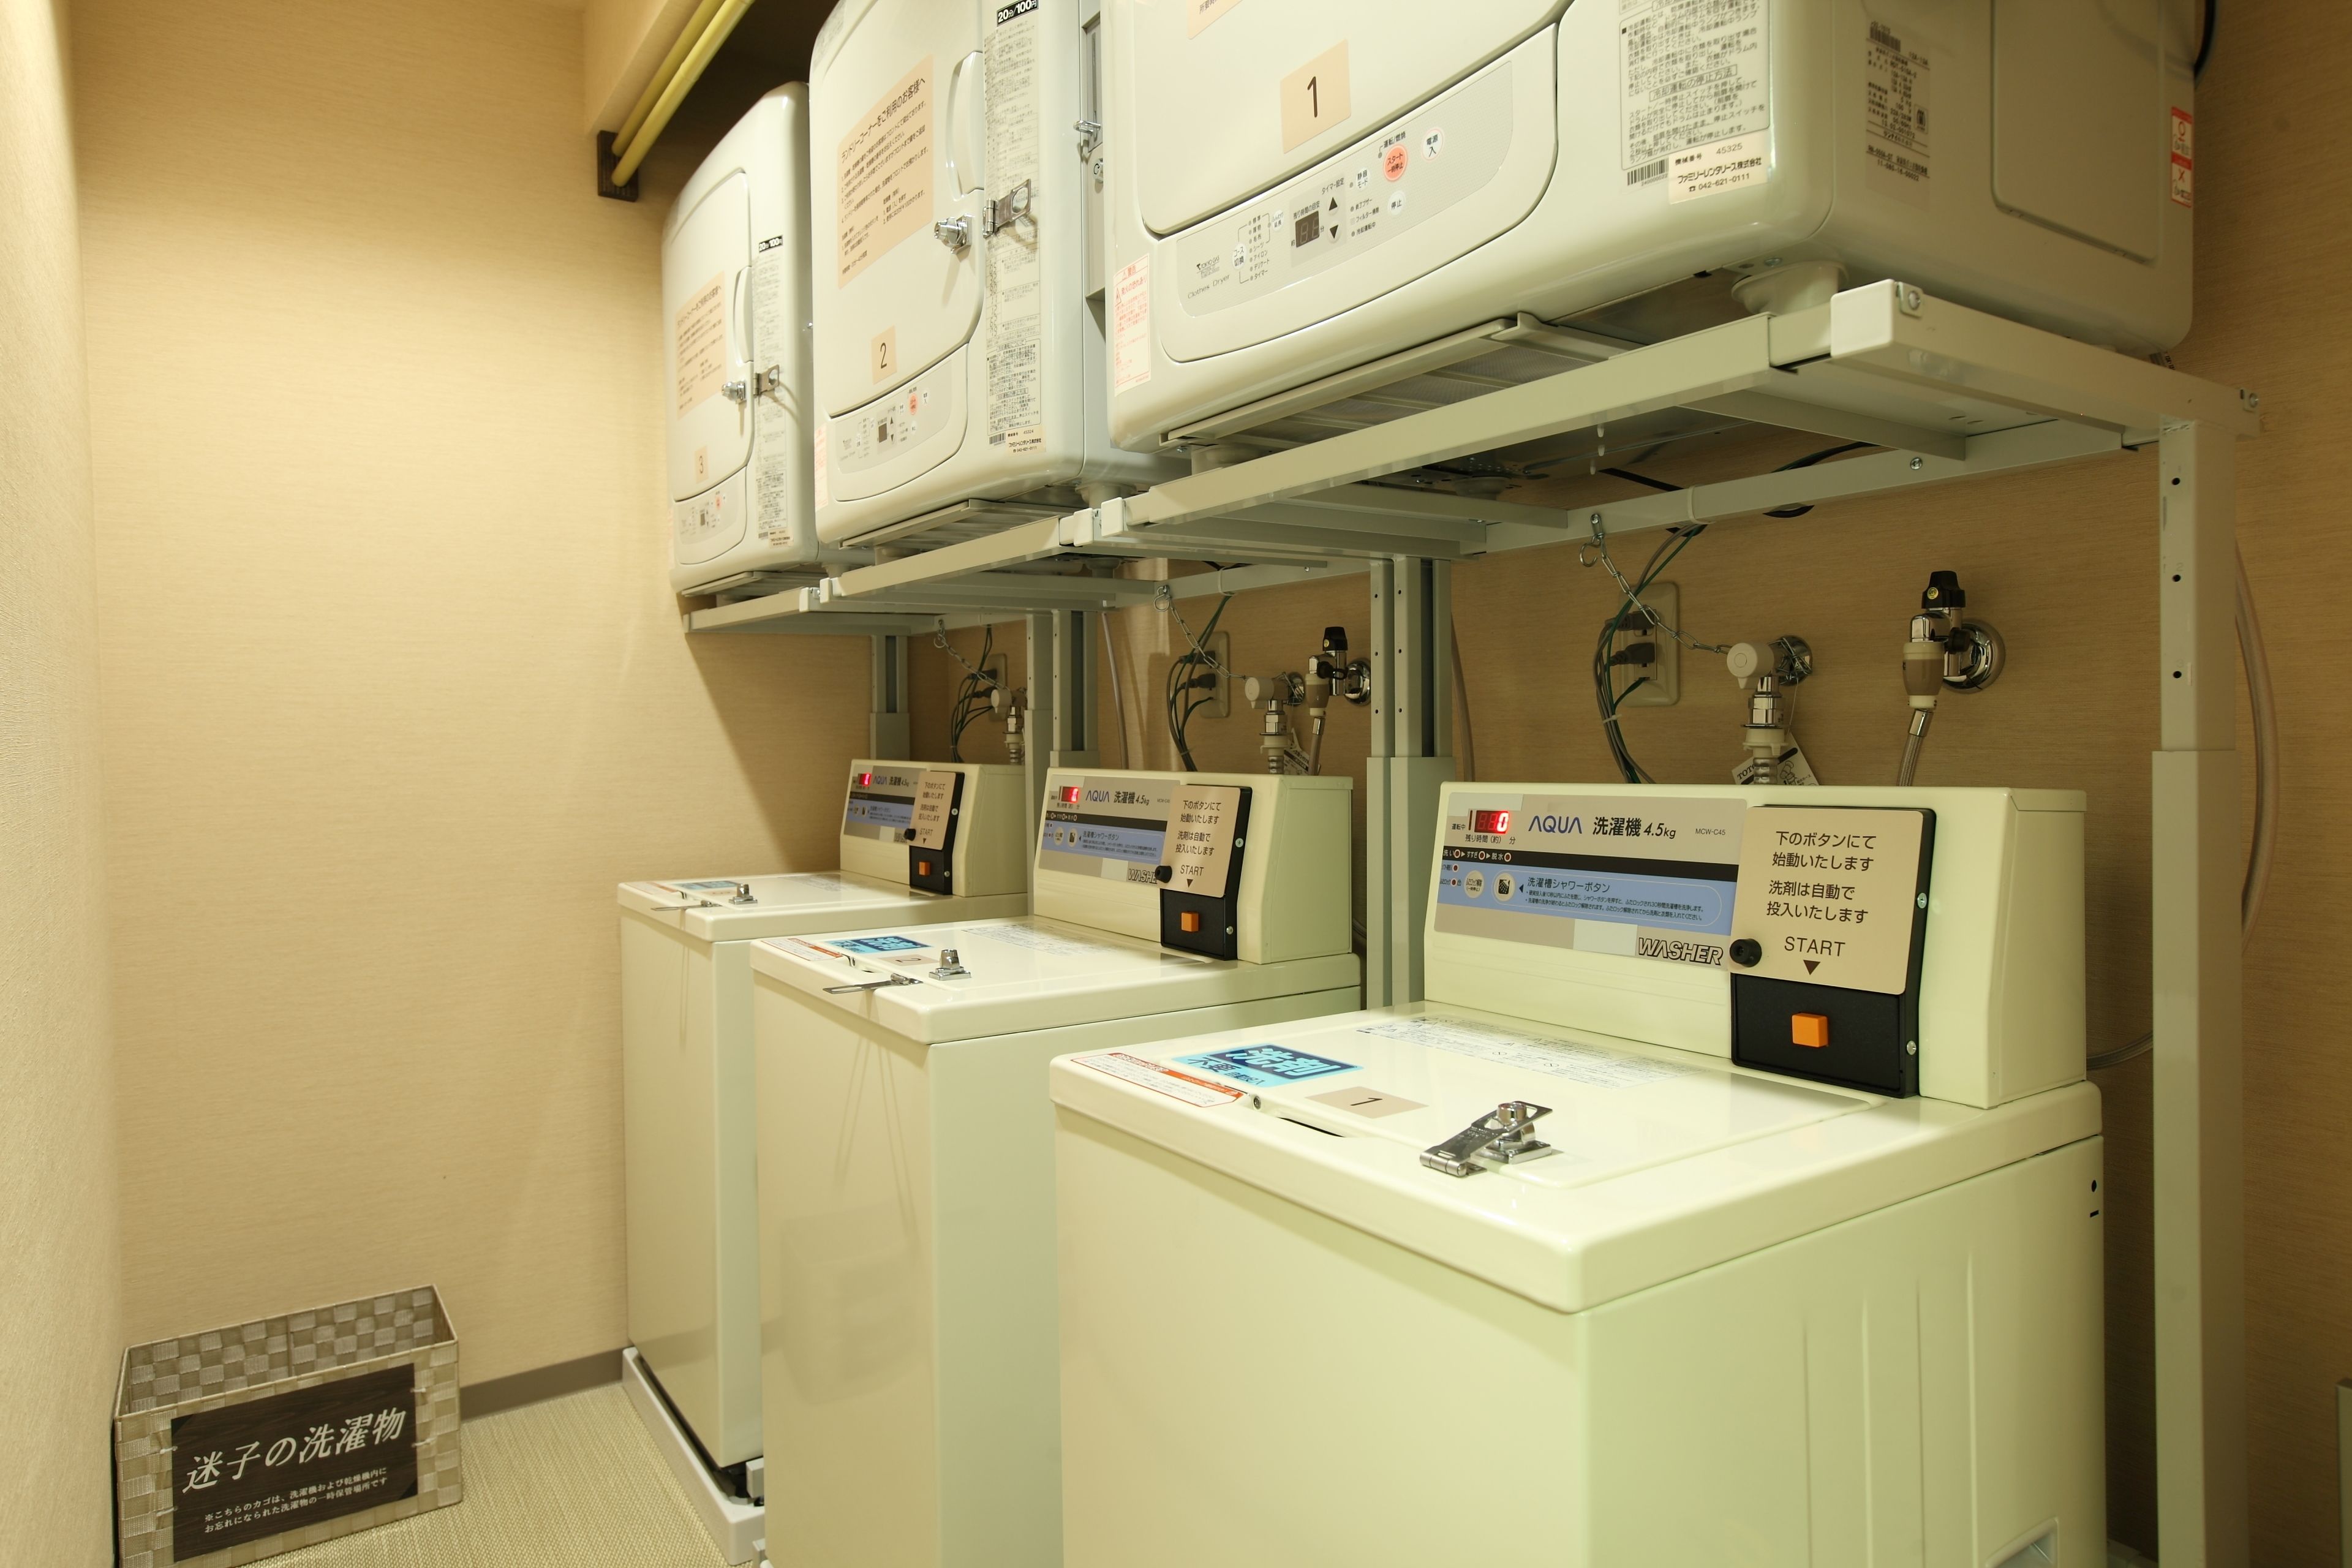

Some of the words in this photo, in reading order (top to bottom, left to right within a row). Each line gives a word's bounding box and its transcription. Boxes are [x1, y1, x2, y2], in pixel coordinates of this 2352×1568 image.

[1306, 76, 1318, 118] 1
[842, 78, 925, 164] ランドリーコーナーをご利用のお客様へ
[1427, 134, 1439, 146] 電源
[1428, 146, 1437, 157] 入
[1716, 142, 1743, 156] 45325
[1387, 153, 1403, 165] スタート
[1387, 162, 1403, 173] 一時停止
[1677, 157, 1763, 184] ファミリーレンタリース株式会社
[1698, 173, 1750, 190] 042-621-0111
[1391, 199, 1402, 209] 停止
[1234, 246, 1244, 257] コース
[1254, 270, 1268, 280] タイマー
[1188, 284, 1210, 299] Clothes
[1212, 274, 1230, 287] Dryer
[880, 342, 888, 369] 2
[698, 455, 704, 474] 3
[1085, 790, 1110, 803] AQUA
[1113, 790, 1136, 805] 洗濯機
[1136, 794, 1150, 806] 4.5kg
[1183, 799, 1221, 812] 下のボタンにて
[1180, 813, 1219, 824] 始動いたします
[1496, 812, 1509, 832] 0
[919, 827, 933, 837] START
[1528, 815, 1583, 834] AQUA
[1592, 816, 1642, 837] 洗濯機
[1643, 822, 1677, 840] 4.5kg
[1694, 827, 1726, 836] MCW-C45
[1177, 830, 1211, 842] 洗剤は自動で
[1509, 836, 1516, 845] 分
[1776, 831, 1877, 850] 下のボタンにて
[1175, 843, 1215, 856] 投入いたします
[1491, 852, 1504, 861] 脱水
[1771, 851, 1874, 872] 始動いたします
[1128, 868, 1158, 884] WASHE
[1180, 864, 1204, 876] START
[1526, 876, 1610, 893] 洗濯槽シャワーボタン
[1768, 880, 1856, 900] 洗剤は自動で
[1766, 900, 1869, 924] 投入いたします
[1638, 937, 1724, 965] WASHER
[1784, 936, 1846, 957] START
[1187, 1057, 1245, 1073] 不要
[1225, 1047, 1342, 1076] 洗剤
[1349, 1096, 1384, 1107] 1
[181, 1407, 407, 1494] 迷子の洗濯物
[205, 1477, 388, 1534] お忘れになられた洗濯物の一時保管場所です
